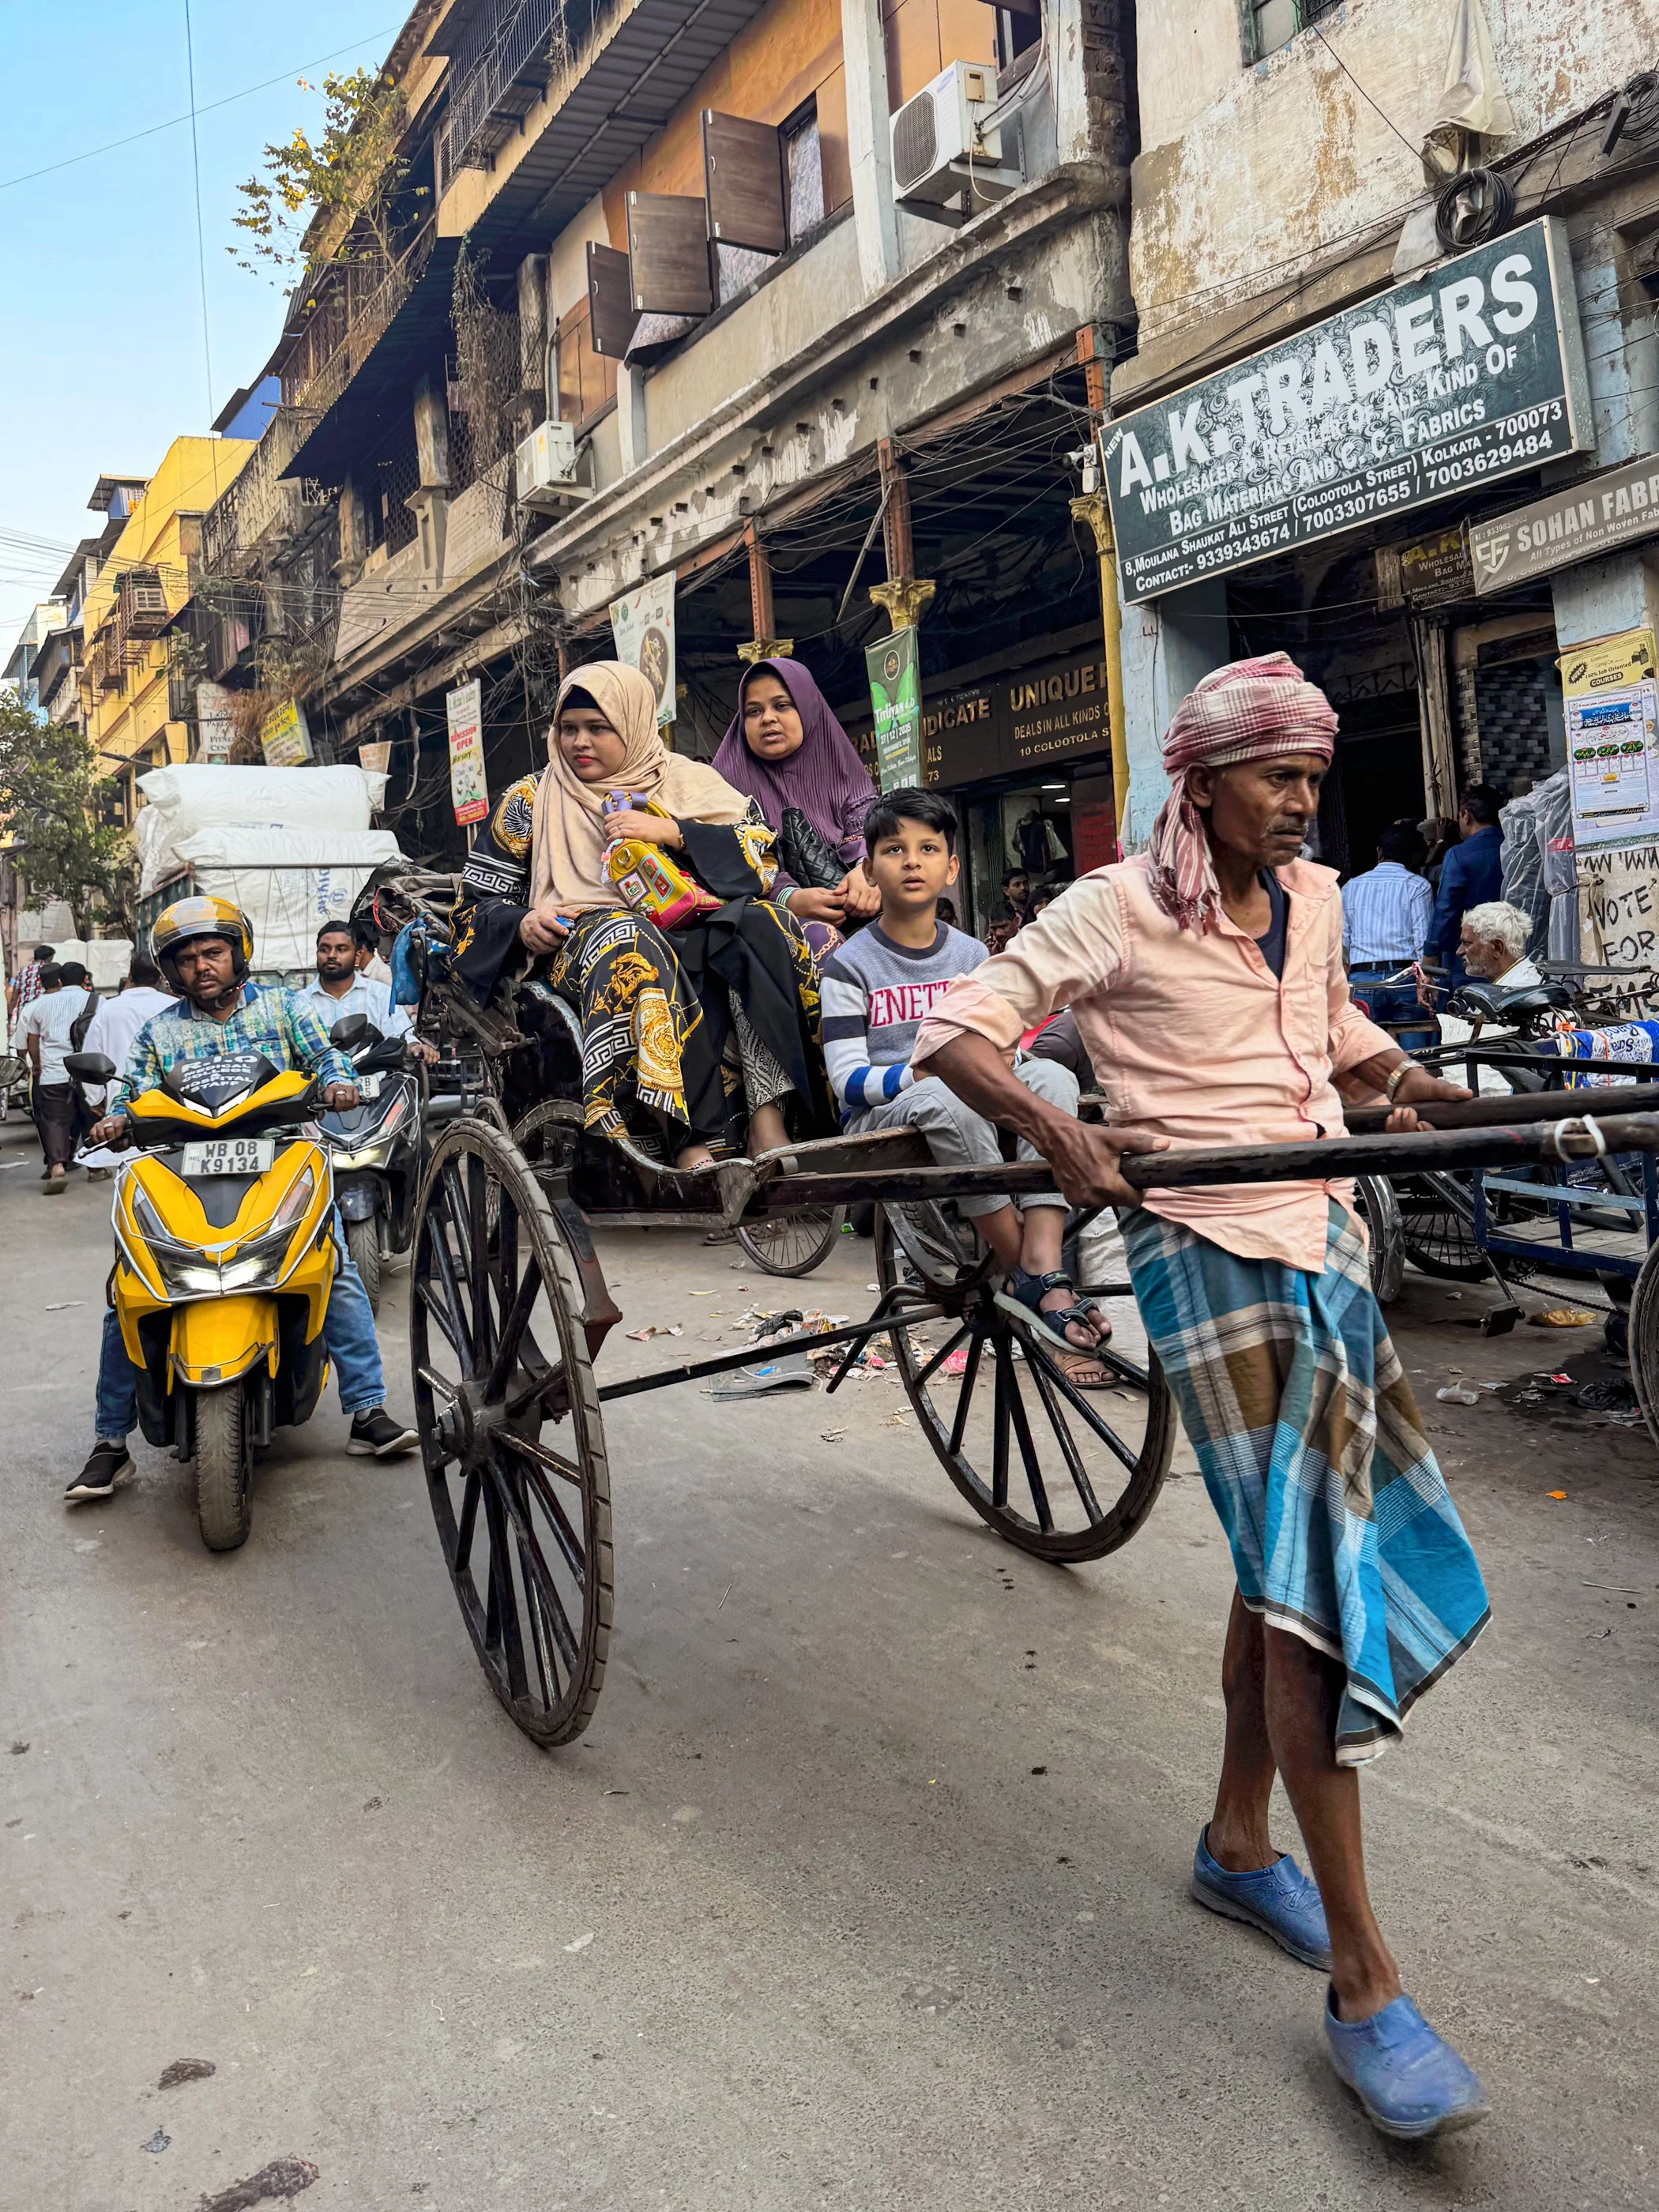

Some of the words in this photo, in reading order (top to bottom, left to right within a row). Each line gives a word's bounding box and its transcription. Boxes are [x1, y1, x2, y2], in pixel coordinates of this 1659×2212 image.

[1381, 387, 1421, 423] ALL
[1425, 361, 1479, 401] KIND
[1485, 343, 1518, 375] OF
[1104, 427, 1125, 460] NEW
[1168, 509, 1203, 537] BAG
[1205, 474, 1293, 523] MATERIALS
[1297, 454, 1336, 486] AND
[1401, 398, 1486, 447] FABRICS
[1181, 529, 1225, 556] SHAUKAT
[1228, 521, 1247, 538] ALI
[1249, 506, 1290, 531] STREET
[1292, 481, 1364, 517] (COLOOTOLA
[1365, 454, 1419, 487] STREET)
[1421, 436, 1482, 468] KOLKATA
[1495, 401, 1563, 440] 700073
[1196, 522, 1291, 570] 9339343674
[1303, 480, 1411, 532] 7003307655
[1425, 429, 1553, 489] 7003629484
[1517, 499, 1596, 553] SOHAN
[1529, 548, 1542, 562] All
[1545, 540, 1571, 557] Types
[1573, 534, 1583, 546] of
[1586, 528, 1604, 542] Non
[1607, 517, 1639, 534] Woven
[1590, 672, 1623, 687] COURSES
[1608, 661, 1632, 673] Oriented
[1010, 665, 1096, 713] UNIQUE
[923, 697, 991, 738] DICATE
[1054, 713, 1070, 732] ALL
[1071, 706, 1101, 726] KINDS
[457, 736, 473, 750] OPEN
[1033, 729, 1099, 754] COLOOTOLA
[1593, 884, 1653, 931] VOTE
[1601, 929, 1656, 967] FOR
[179, 1074, 254, 1093] HOSPITAL
[182, 1068, 251, 1083] COLLEGE
[183, 1063, 251, 1078] MEDICAL
[190, 1081, 239, 1093] STAFF
[205, 1142, 228, 1158] WB
[235, 1141, 258, 1157] 08
